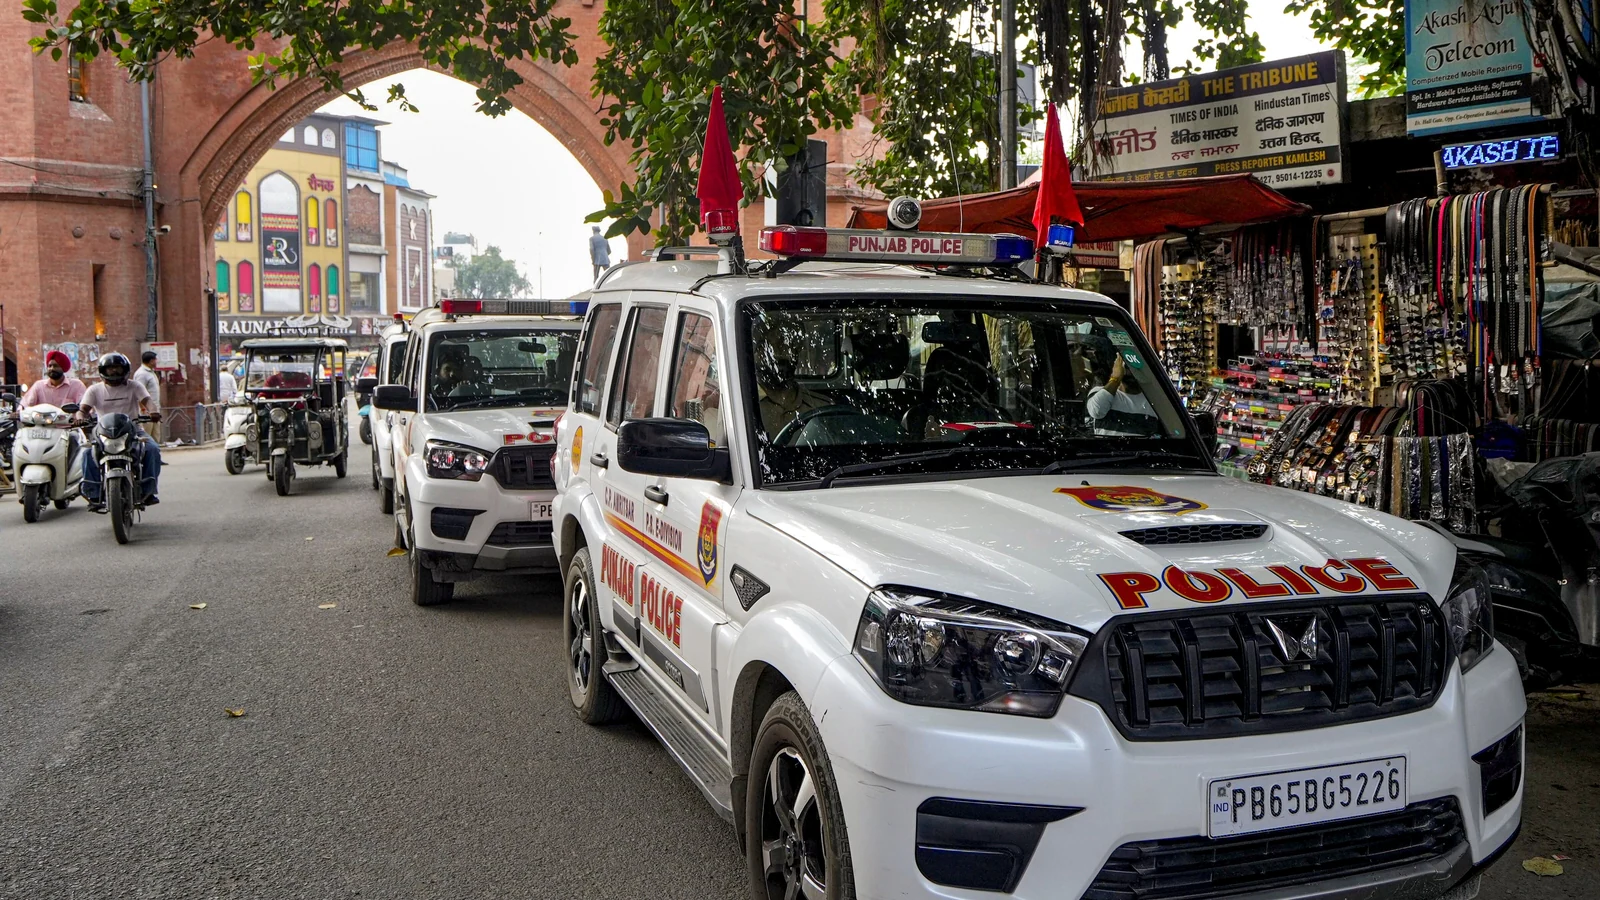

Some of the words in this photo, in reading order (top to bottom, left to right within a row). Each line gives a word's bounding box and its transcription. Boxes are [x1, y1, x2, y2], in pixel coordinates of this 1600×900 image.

[1415, 6, 1467, 35] Akash
[1425, 38, 1516, 71] Telecom
[1202, 76, 1235, 97] THE
[1240, 61, 1318, 90] TRIBUNE
[1411, 73, 1460, 86] Computerized
[1461, 67, 1485, 78] Mobile
[1486, 63, 1523, 75] Repairing
[1416, 100, 1447, 110] Hardware
[1447, 96, 1470, 105] Service
[1470, 91, 1501, 101] Available
[1502, 89, 1518, 97] Here
[1424, 92, 1432, 100] In
[1436, 88, 1456, 98] Mobile
[1457, 84, 1491, 95] Unlocking,
[1491, 79, 1523, 90] Software,
[1254, 95, 1301, 112] Hindustan
[1301, 91, 1330, 104] Times
[1170, 110, 1197, 124] TIMES
[1199, 108, 1211, 120] OF
[1213, 104, 1239, 118] INDIA
[1255, 116, 1284, 132] दैनिक
[1285, 112, 1325, 128] जागरण
[1170, 129, 1201, 145] दैनिक
[1201, 126, 1239, 140] भास्कर
[1258, 136, 1288, 150] उत्तम
[1215, 161, 1241, 173] PRESS
[1241, 155, 1284, 170] REPORTER
[1286, 150, 1326, 165] KAMLESH
[1443, 140, 1519, 168] AKASH
[1275, 169, 1323, 183] 95014-12235
[849, 235, 908, 254] PUNJAB
[911, 237, 962, 255] POLICE
[219, 320, 285, 336] RAUNAK
[1124, 353, 1141, 364] OK
[604, 486, 612, 509] C.P.
[612, 492, 635, 523] AMRITSAR
[646, 511, 655, 536] P.S.
[656, 517, 683, 553] E-DIVISION
[601, 543, 635, 607] PUNJAB
[1096, 558, 1420, 611] POLICE
[640, 571, 684, 649] POLICE
[1231, 767, 1400, 824] PB65BG5226
[1213, 802, 1229, 813] IND
